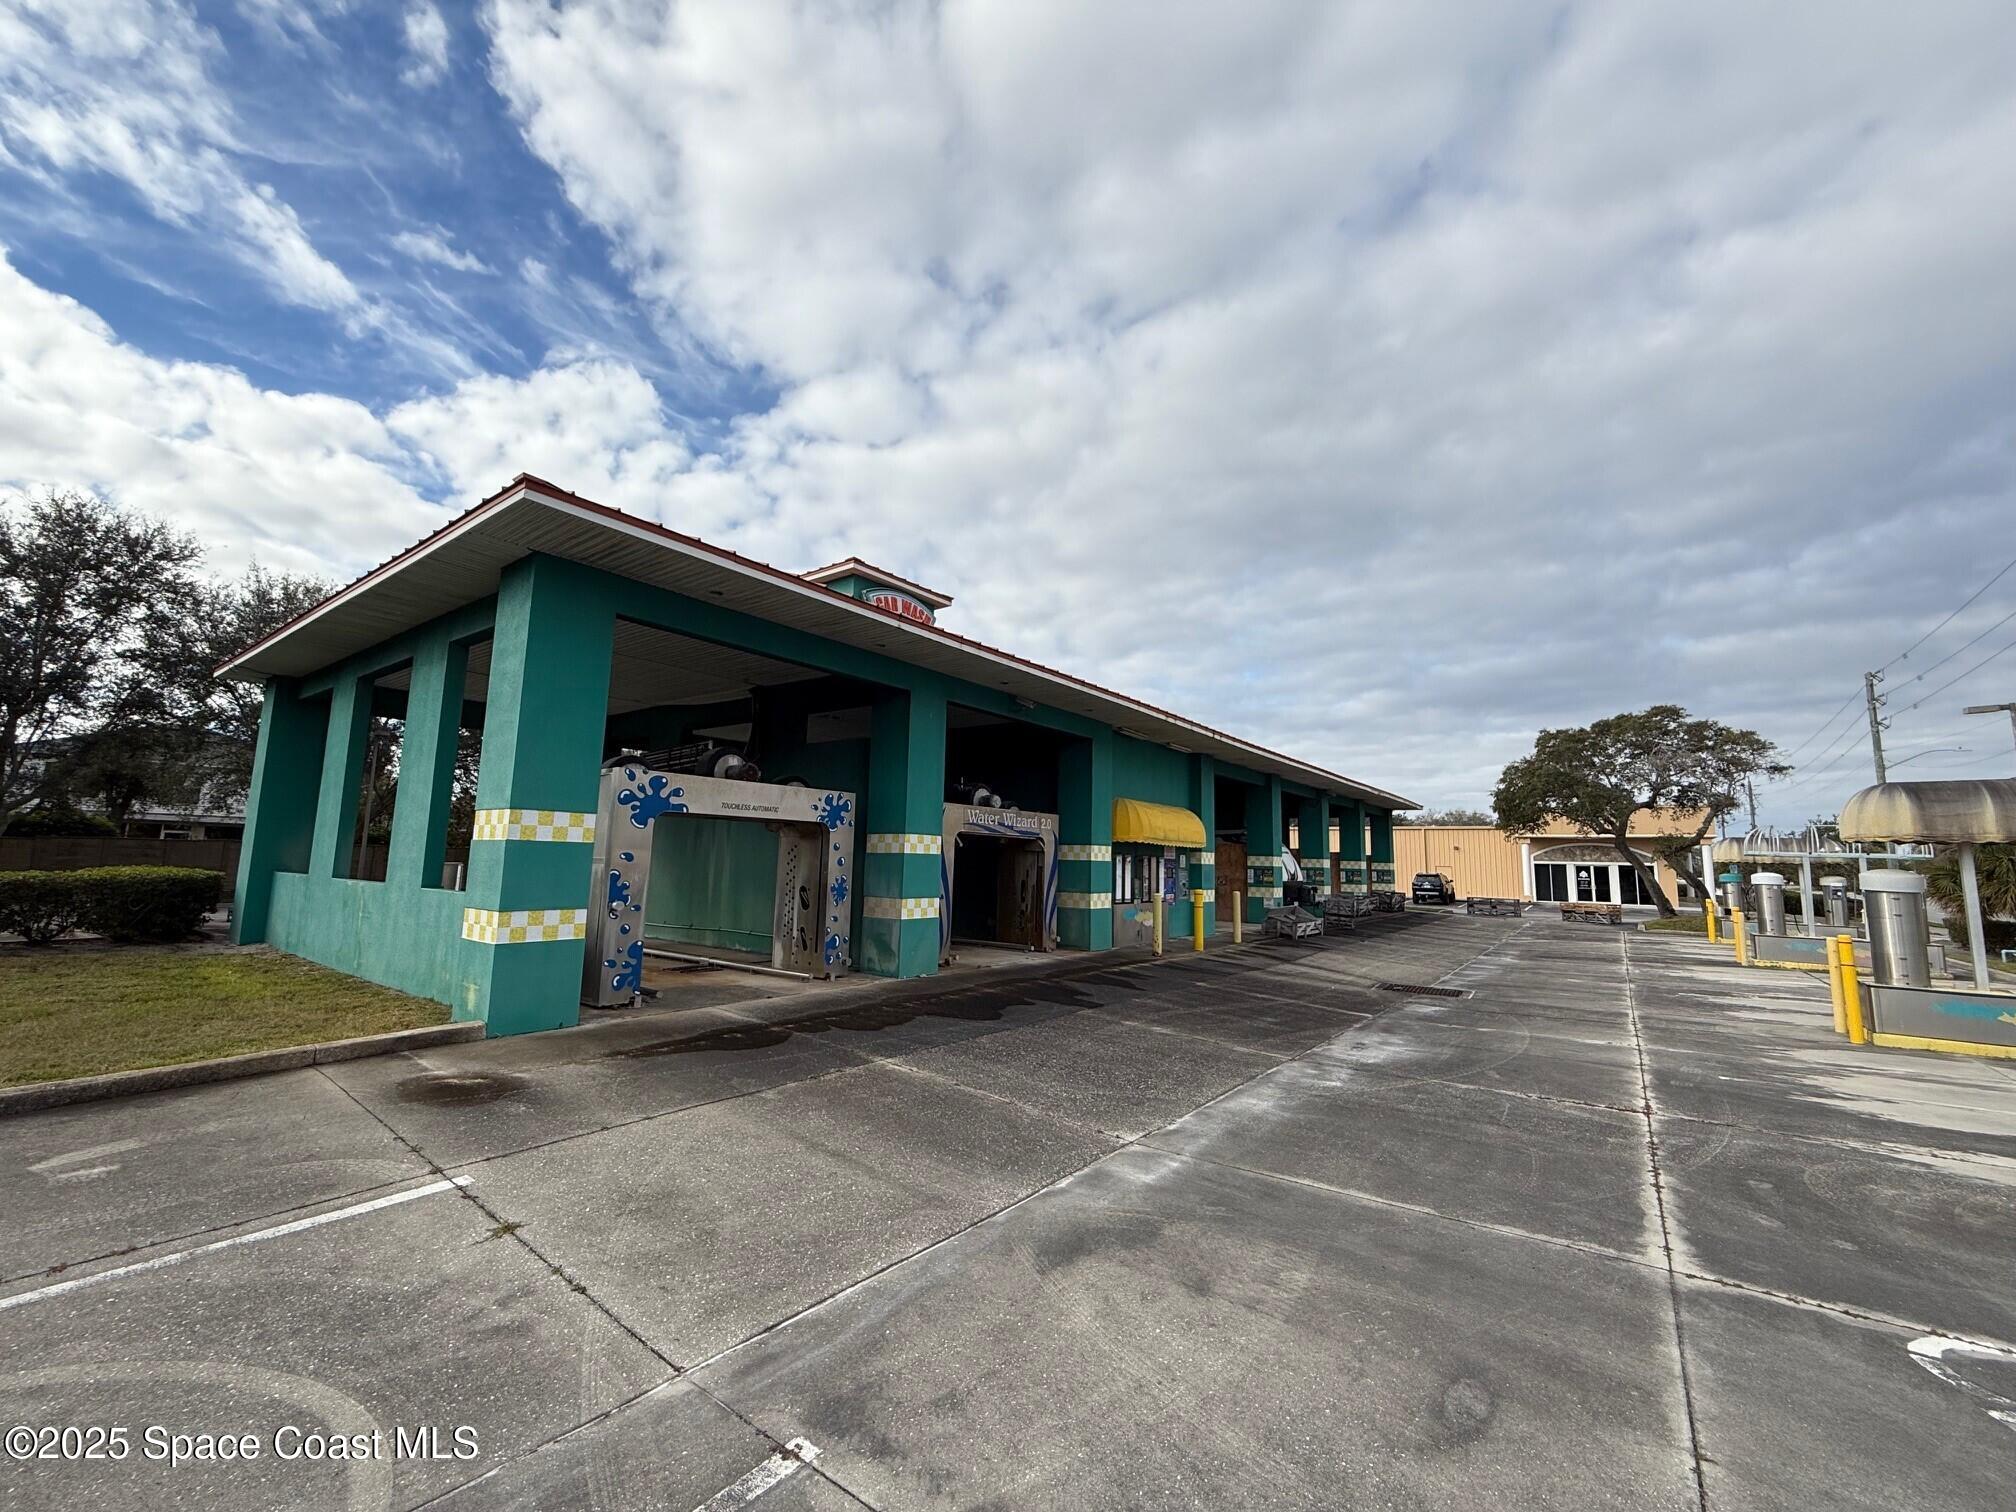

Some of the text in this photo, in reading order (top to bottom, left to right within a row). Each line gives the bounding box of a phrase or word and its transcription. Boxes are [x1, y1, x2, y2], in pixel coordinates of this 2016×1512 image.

[876, 596, 932, 625] CAR WASH
[721, 801, 780, 813] TOUCHLESS AUTOMATIC
[967, 809, 1052, 829] Water Wizard 2.0
